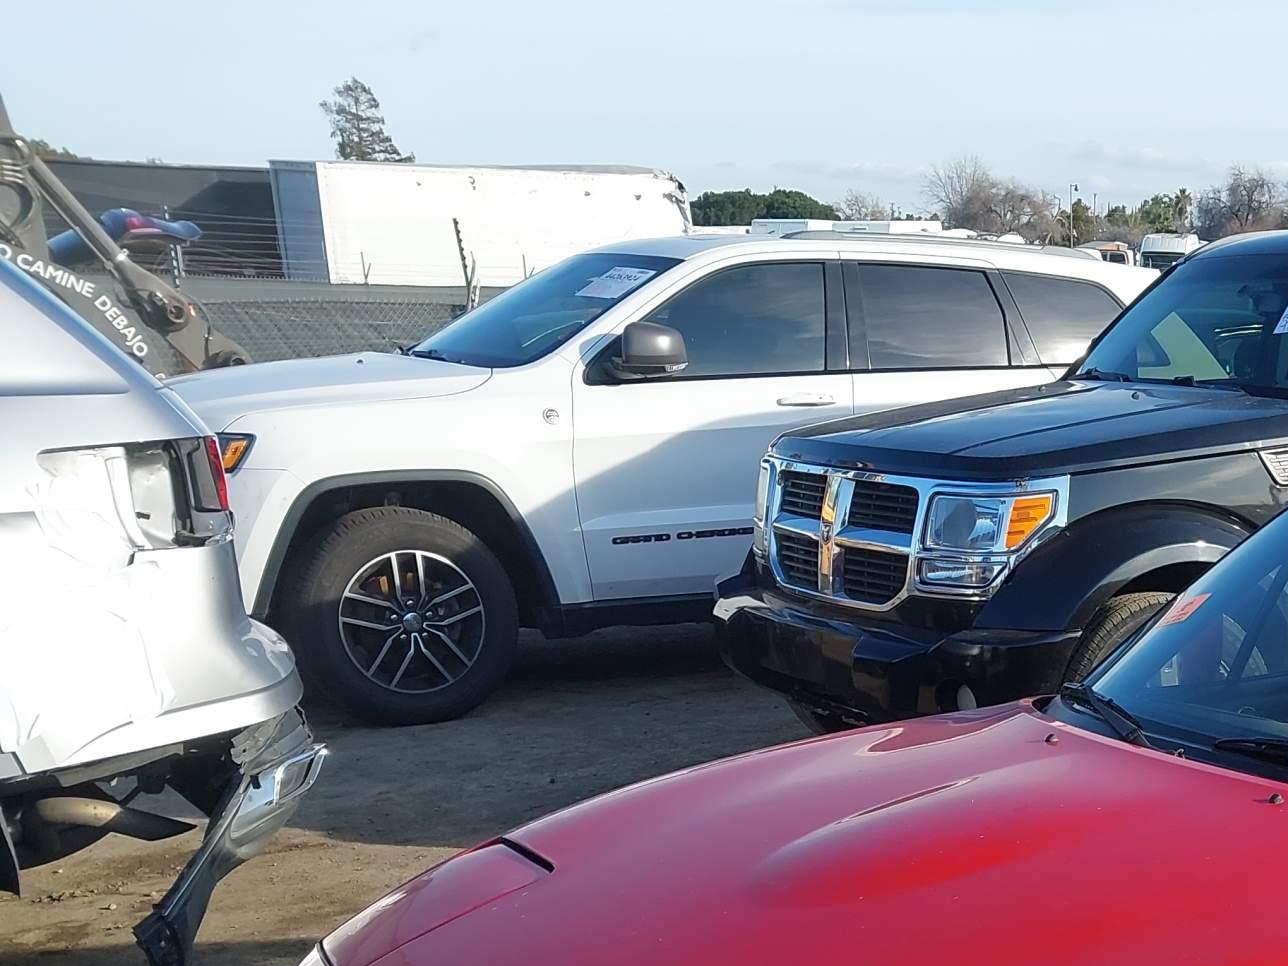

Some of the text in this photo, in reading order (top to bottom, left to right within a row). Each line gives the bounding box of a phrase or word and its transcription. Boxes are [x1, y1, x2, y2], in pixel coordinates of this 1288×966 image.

[16, 254, 97, 299] CAMINE
[94, 295, 149, 357] DEBAJO
[612, 526, 755, 545] GRAND CHEROKE
